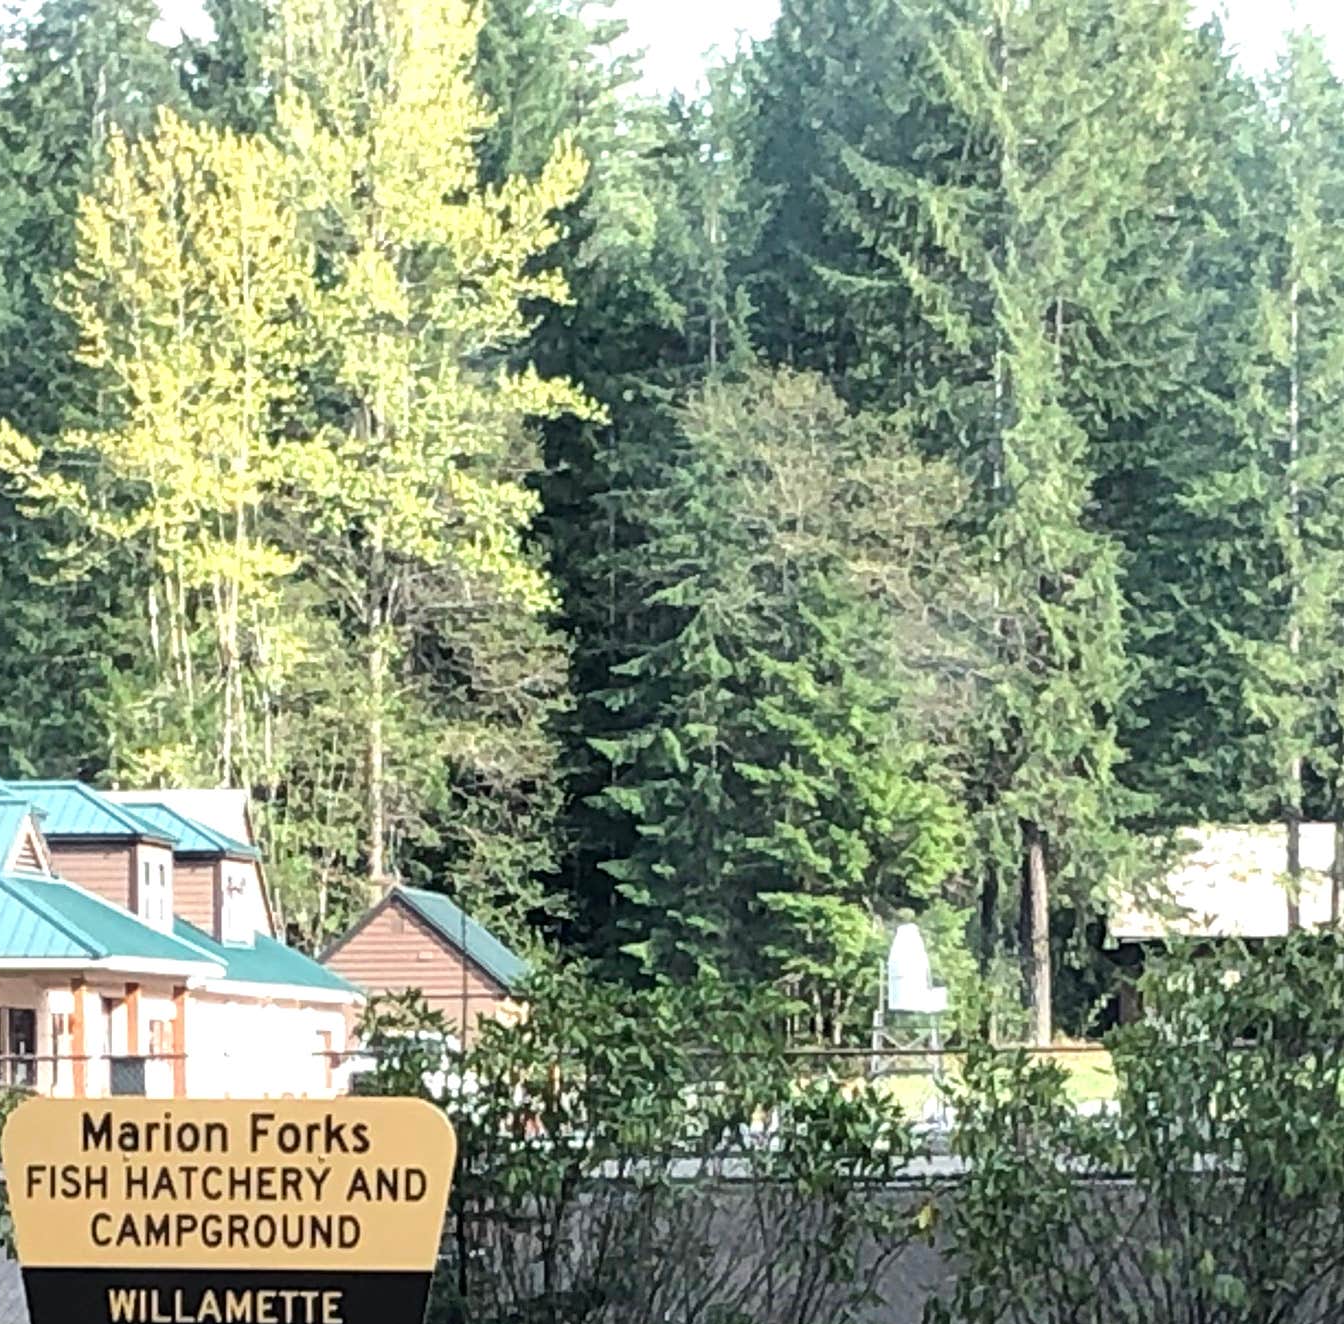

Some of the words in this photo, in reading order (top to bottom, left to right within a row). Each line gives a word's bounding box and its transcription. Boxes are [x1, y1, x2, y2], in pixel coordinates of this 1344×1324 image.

[82, 1111, 228, 1152] Marion
[250, 1112, 371, 1154] Forks
[26, 1164, 108, 1200] FISH
[125, 1165, 332, 1202] HATCHERY
[346, 1167, 427, 1202] AND
[91, 1212, 361, 1249] CAMPGROUND
[107, 1288, 344, 1324] WILLAMETTE
